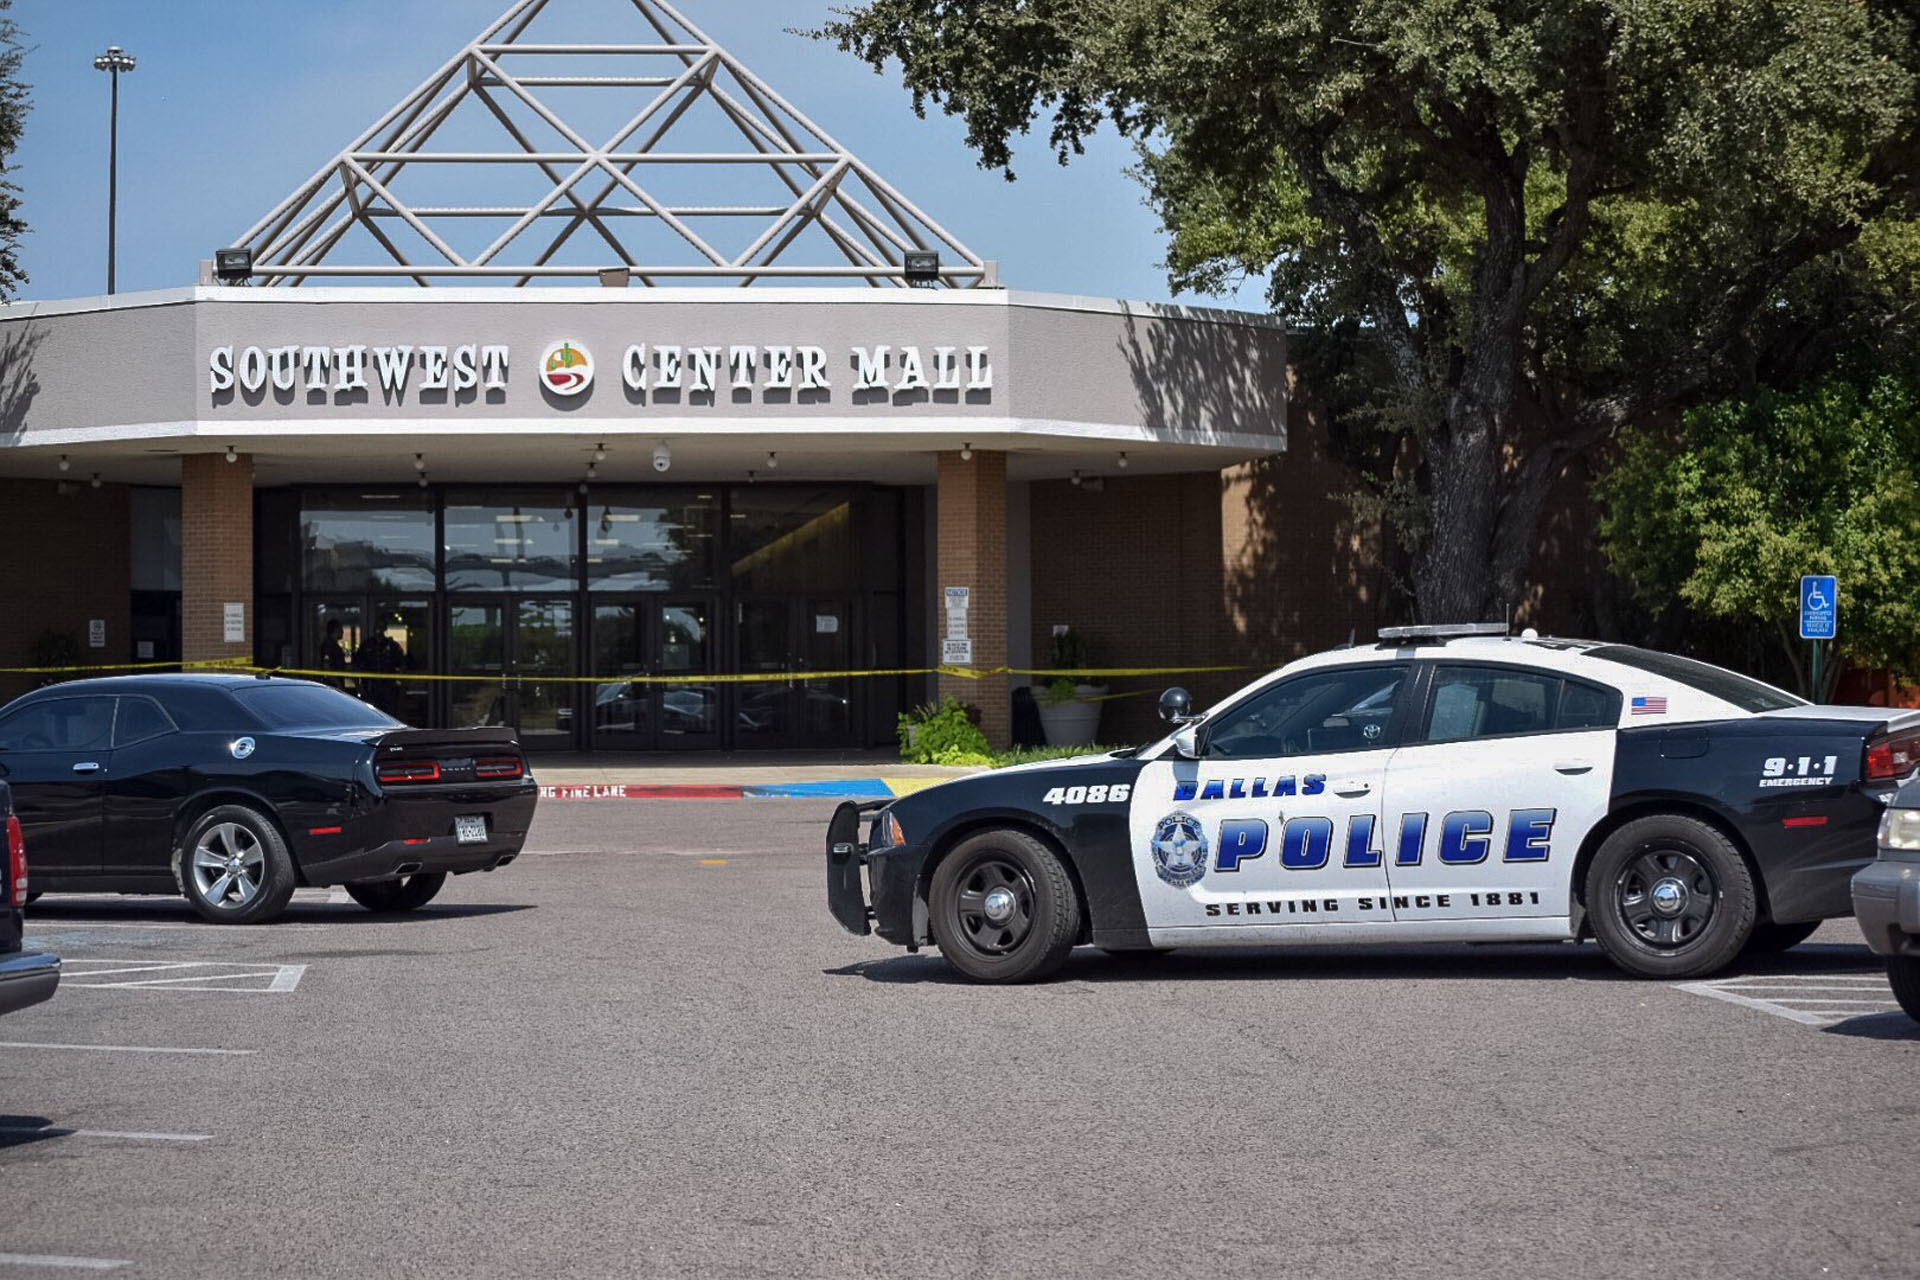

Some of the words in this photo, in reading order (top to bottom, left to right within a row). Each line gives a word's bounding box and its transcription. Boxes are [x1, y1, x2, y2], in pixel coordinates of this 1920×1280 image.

[209, 344, 509, 393] SOUTHWEST
[621, 342, 832, 392] CENTER
[852, 344, 993, 390] MALL
[593, 784, 627, 798] LANE
[1042, 783, 1131, 805] 4086
[1172, 773, 1327, 802] DALLAS
[1758, 776, 1834, 788] EMERGENCY
[1158, 816, 1201, 830] POLICE
[1214, 807, 1557, 873] POLICE
[1205, 898, 1339, 917] SERVING
[1357, 892, 1451, 911] SINCE
[1469, 891, 1540, 907] 1881
